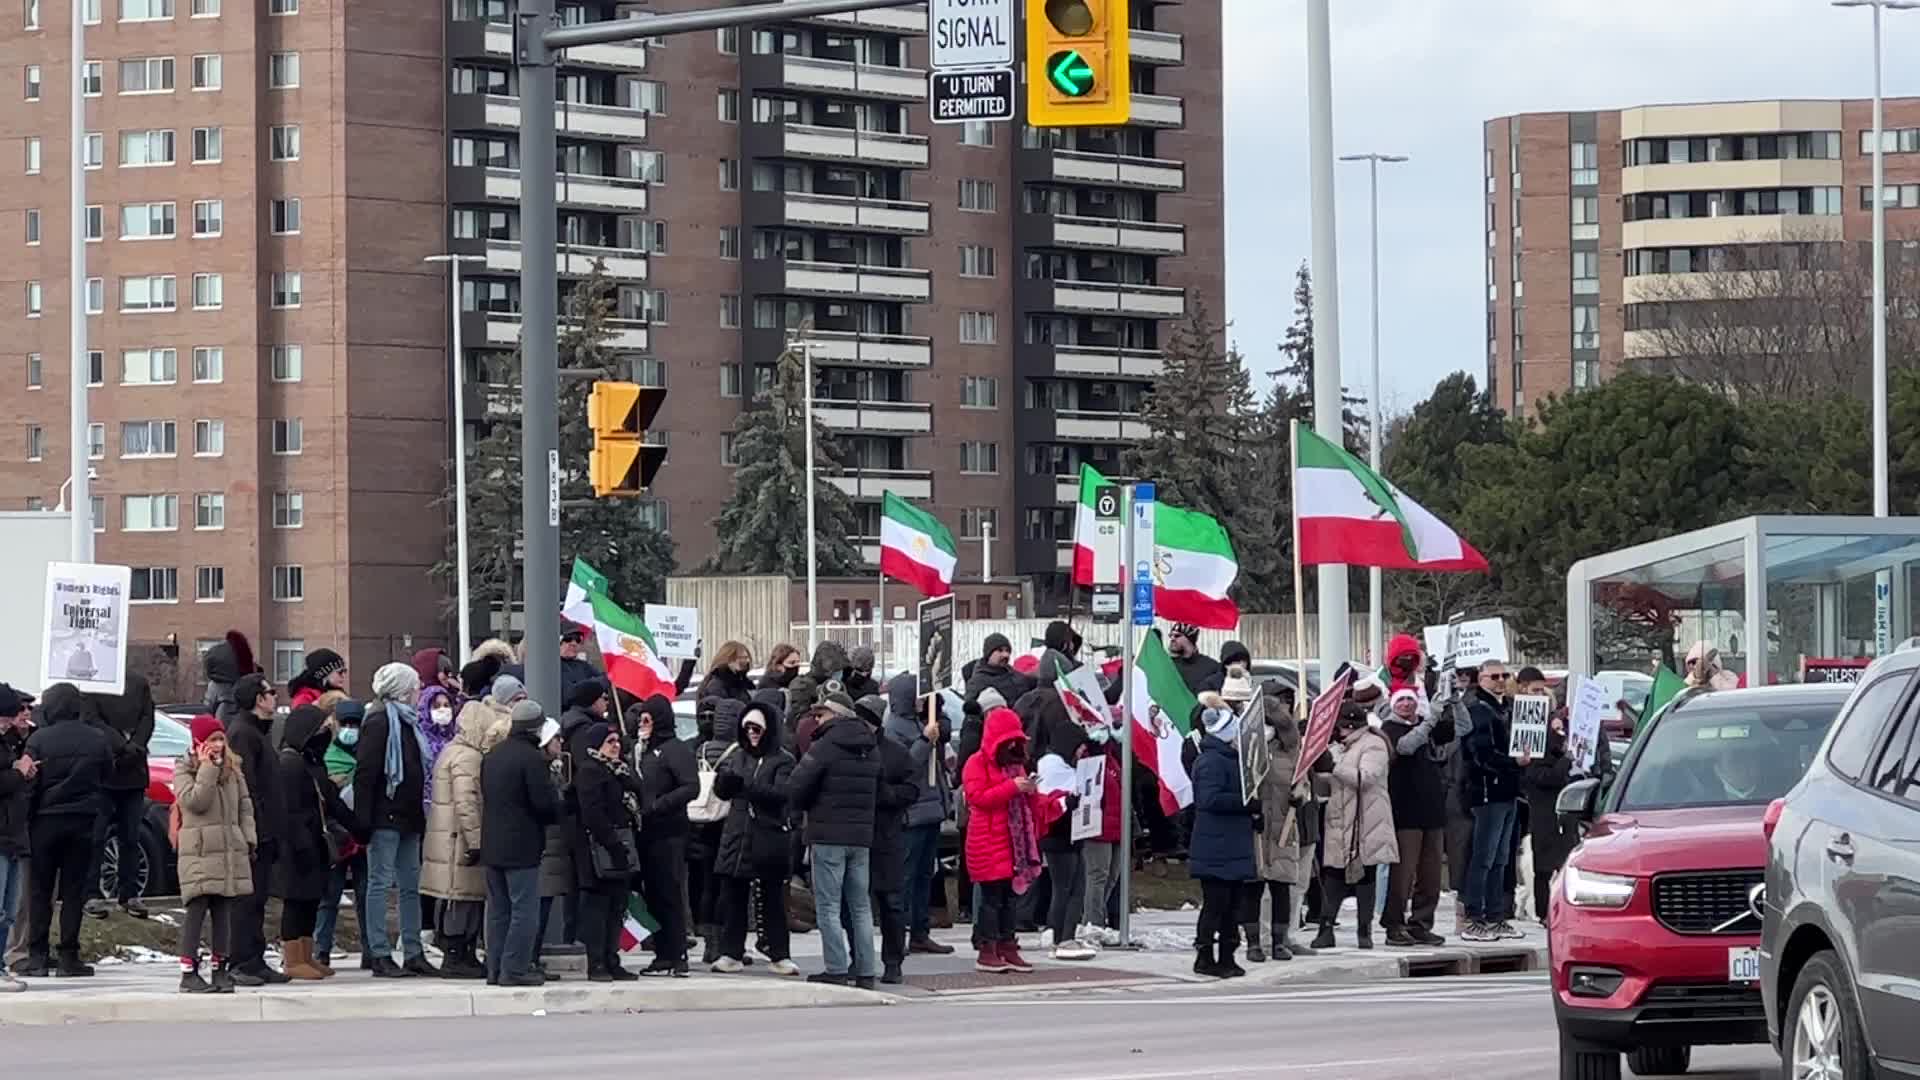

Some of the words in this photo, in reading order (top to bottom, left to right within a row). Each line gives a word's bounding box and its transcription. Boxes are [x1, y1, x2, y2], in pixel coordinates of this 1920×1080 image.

[937, 16, 1006, 49] SIGNAL
[939, 97, 1005, 117] PERMITTED
[1514, 699, 1547, 726] MAHSA
[1511, 730, 1545, 753] AMINI
